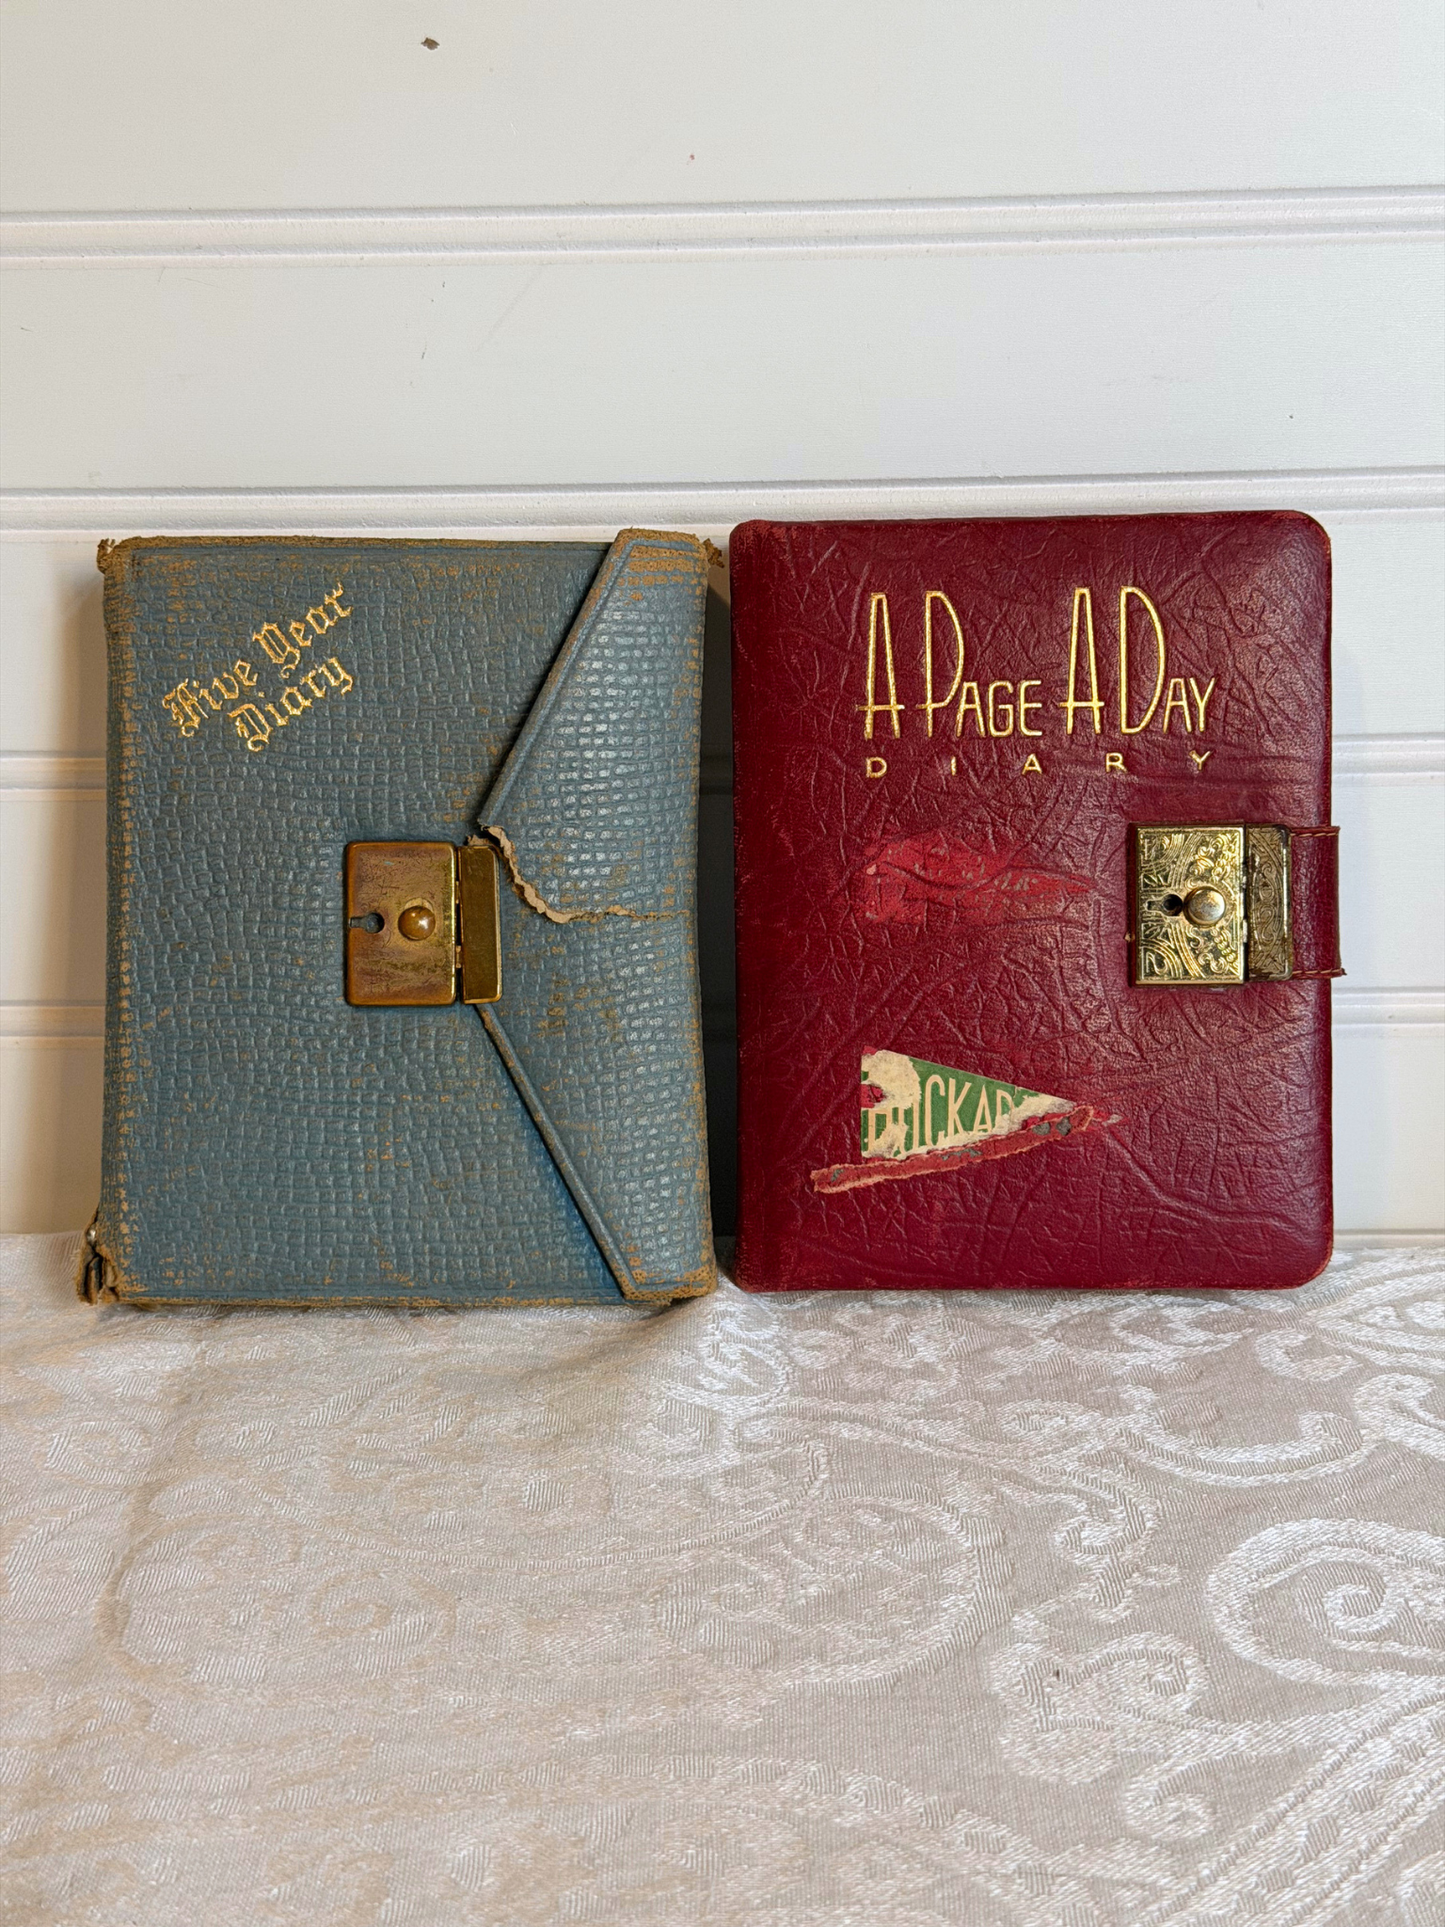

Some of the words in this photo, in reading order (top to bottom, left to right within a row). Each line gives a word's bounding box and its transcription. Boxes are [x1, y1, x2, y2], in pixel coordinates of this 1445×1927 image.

[163, 661, 258, 737] Five
[253, 581, 353, 679] Year
[226, 657, 354, 752] Diary
[856, 592, 905, 739] A
[916, 590, 1043, 737] PAGE
[1058, 586, 1105, 735] A
[1120, 585, 1215, 734] DAY
[865, 751, 1211, 778] DIARY
